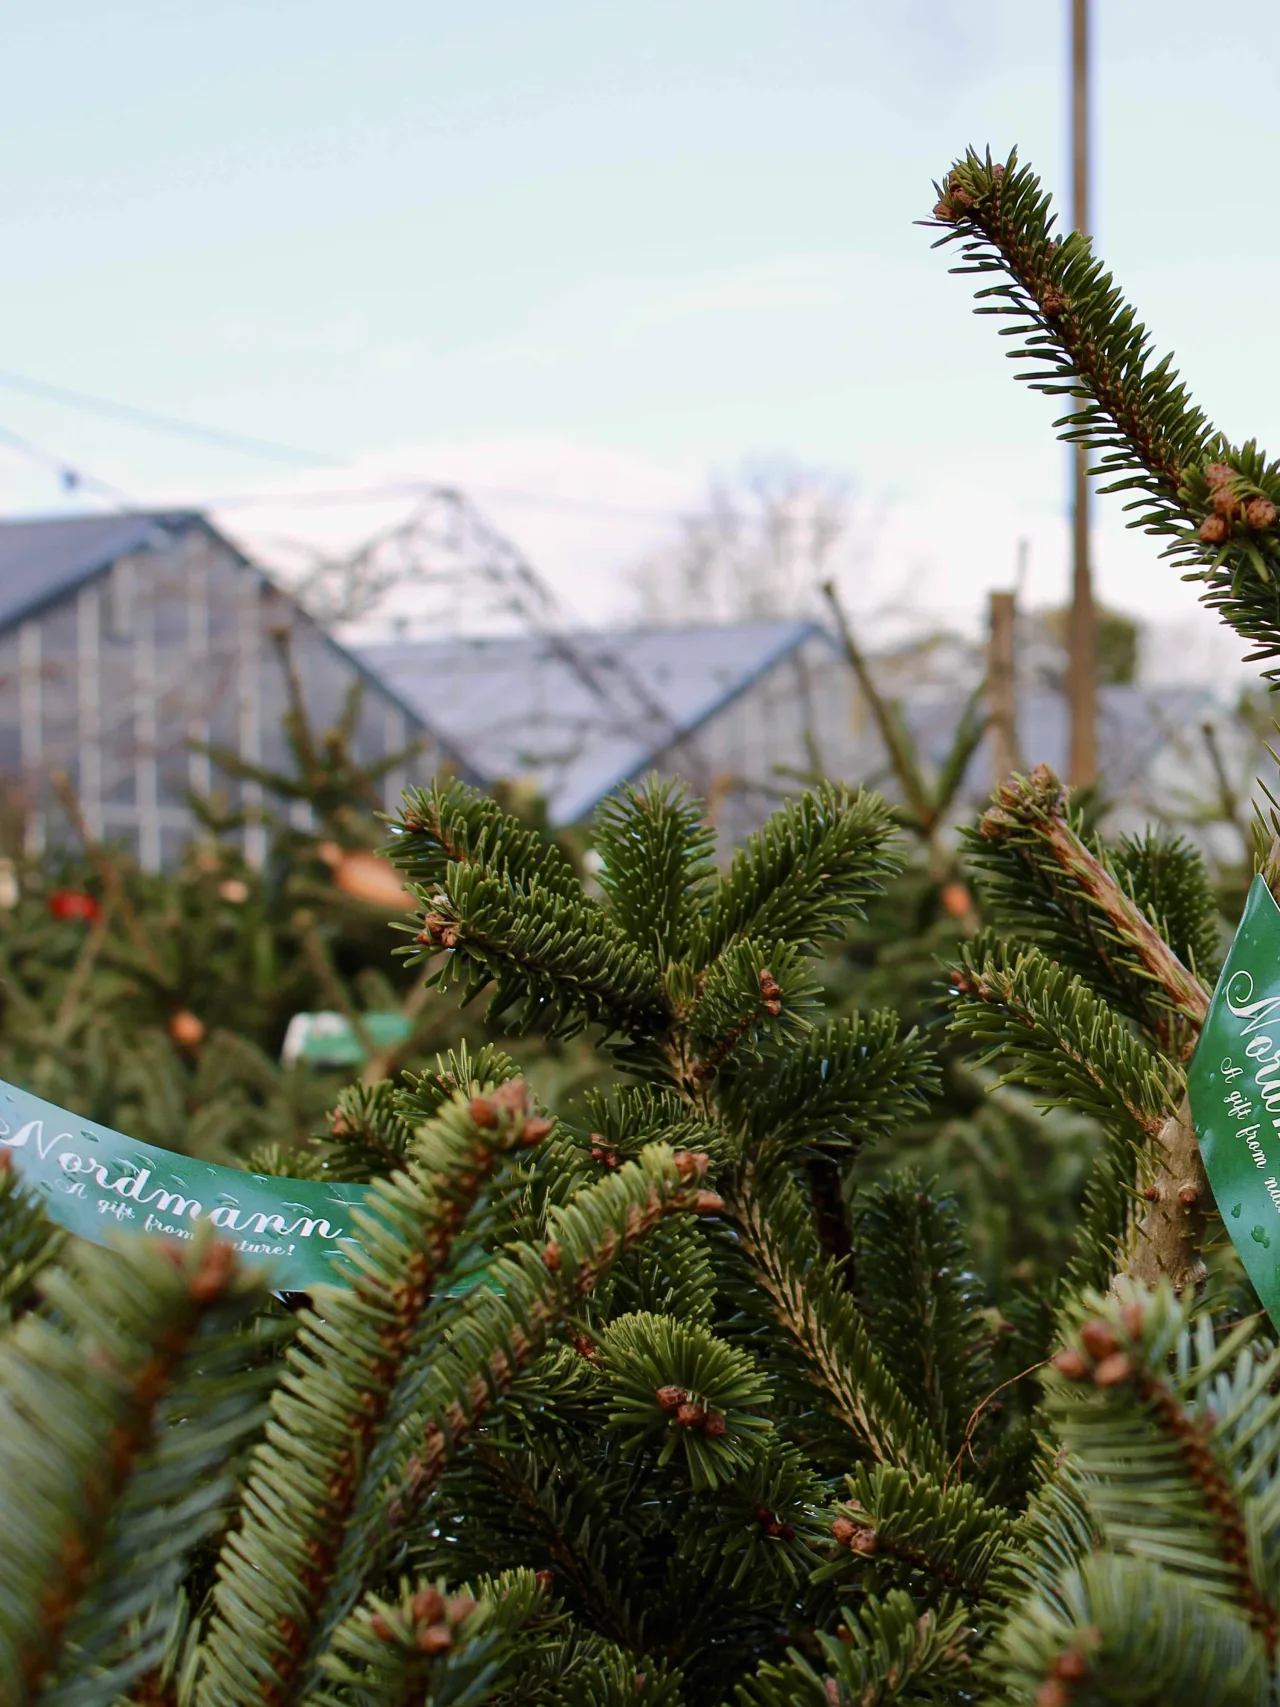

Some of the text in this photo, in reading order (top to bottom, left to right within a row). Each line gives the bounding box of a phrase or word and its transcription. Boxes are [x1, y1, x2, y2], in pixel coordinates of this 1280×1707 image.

[1220, 1057, 1243, 1084] A
[1223, 1090, 1252, 1120] gift
[1235, 1123, 1267, 1169] from
[0, 1118, 343, 1239] Nordmann
[97, 1199, 136, 1221] gift
[144, 1213, 195, 1241] from
